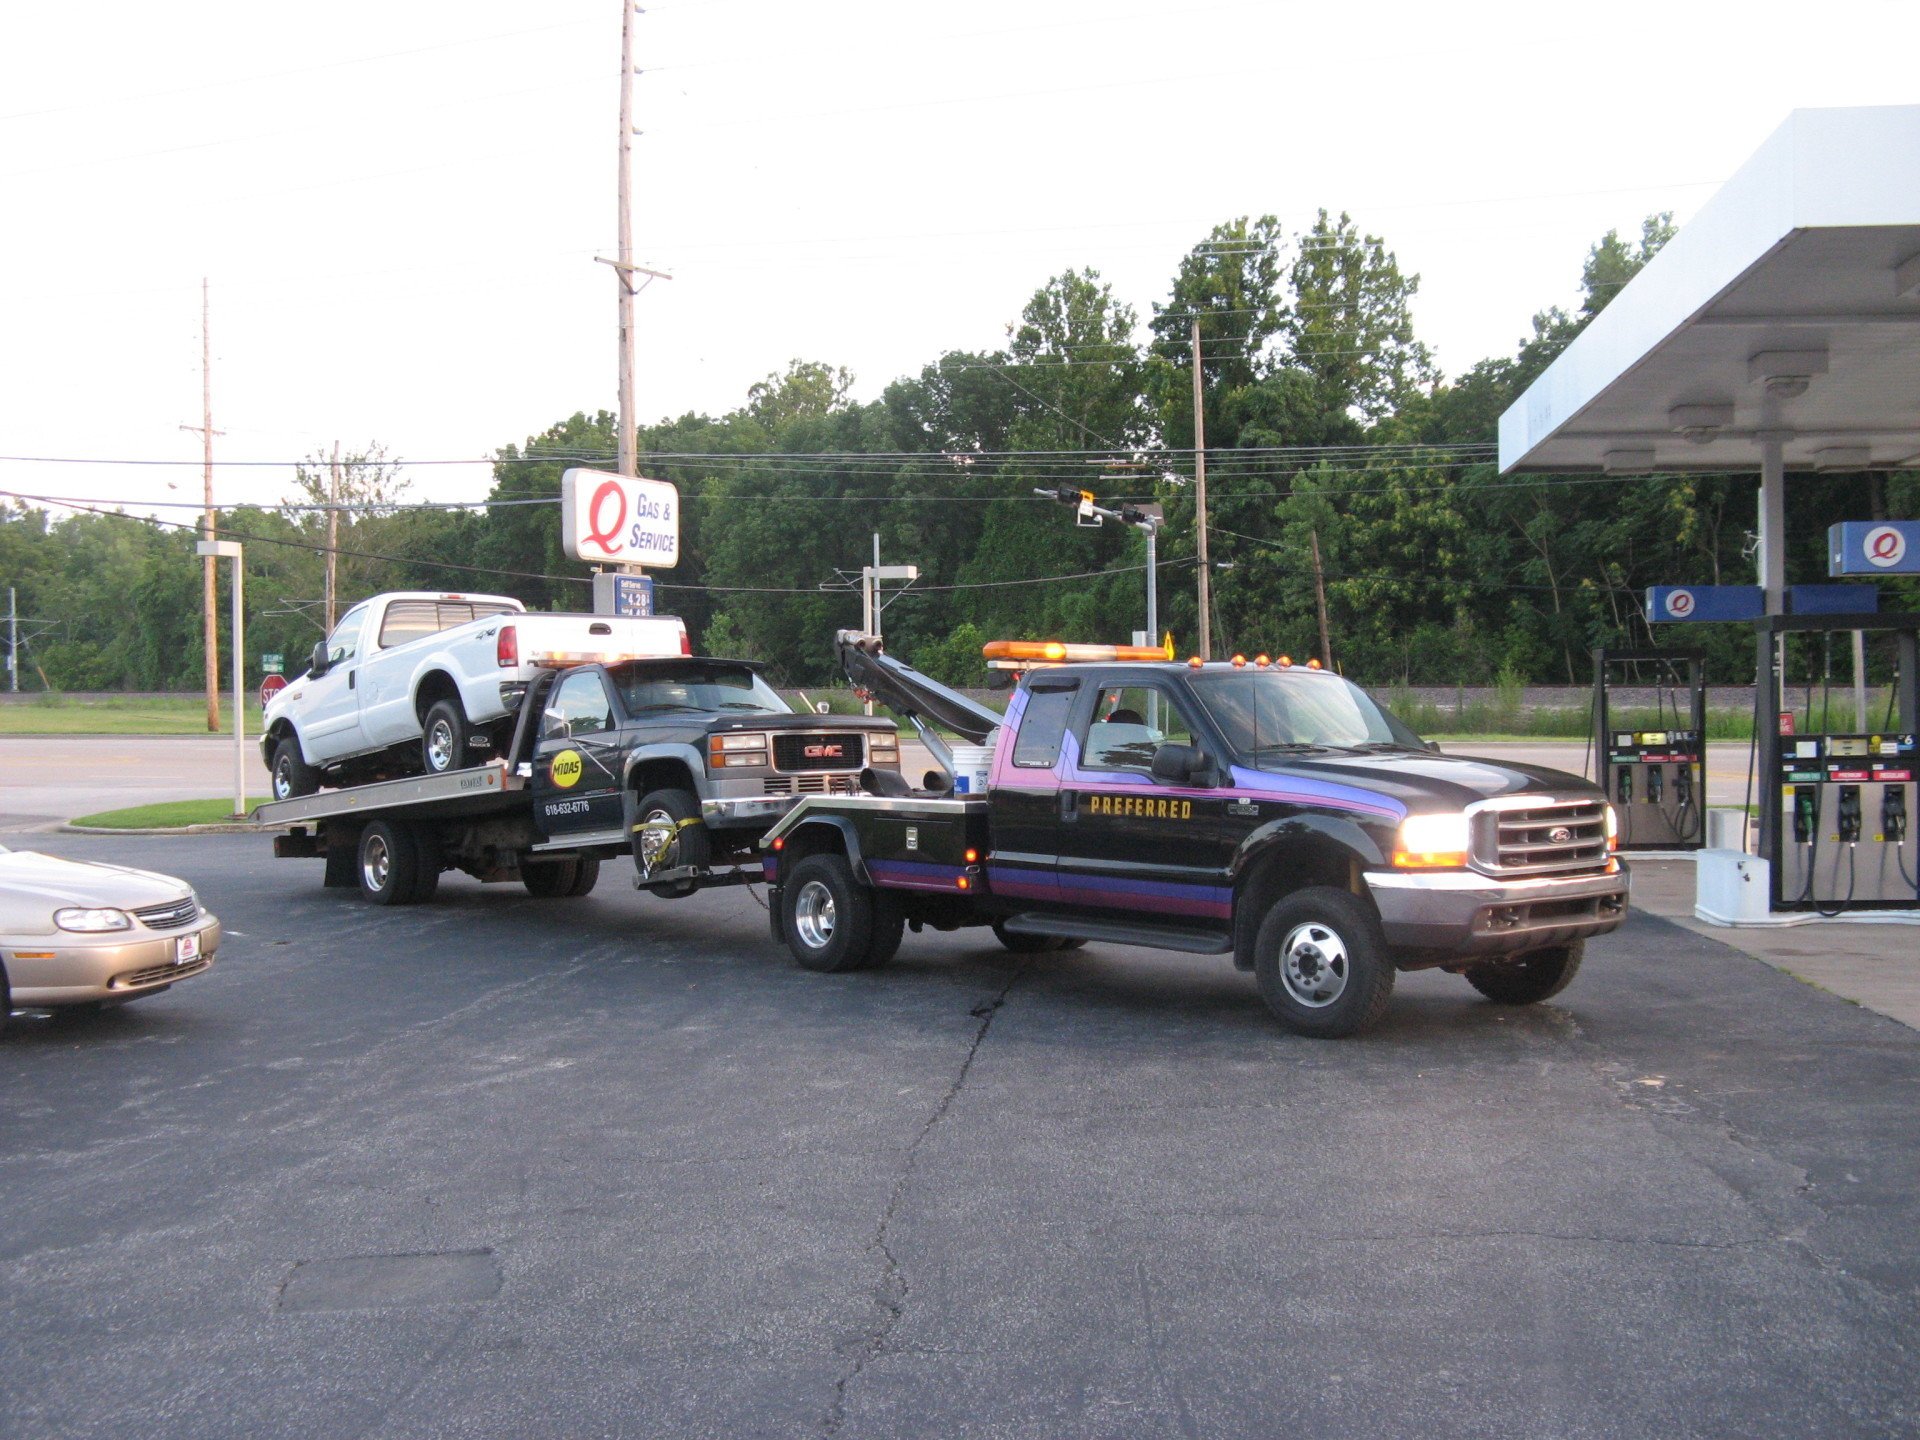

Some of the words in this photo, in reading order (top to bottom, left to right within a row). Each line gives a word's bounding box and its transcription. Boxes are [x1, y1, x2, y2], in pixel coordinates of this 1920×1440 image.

[581, 480, 626, 554] Q
[637, 493, 659, 520] GAS
[630, 523, 675, 552] SERVICE
[1870, 532, 1898, 559] Q
[1670, 594, 1690, 612] Q
[804, 745, 843, 757] GMC
[553, 761, 580, 776] MIDAS
[545, 801, 590, 816] 618-632-6776
[1091, 796, 1191, 819] PREFERRED
